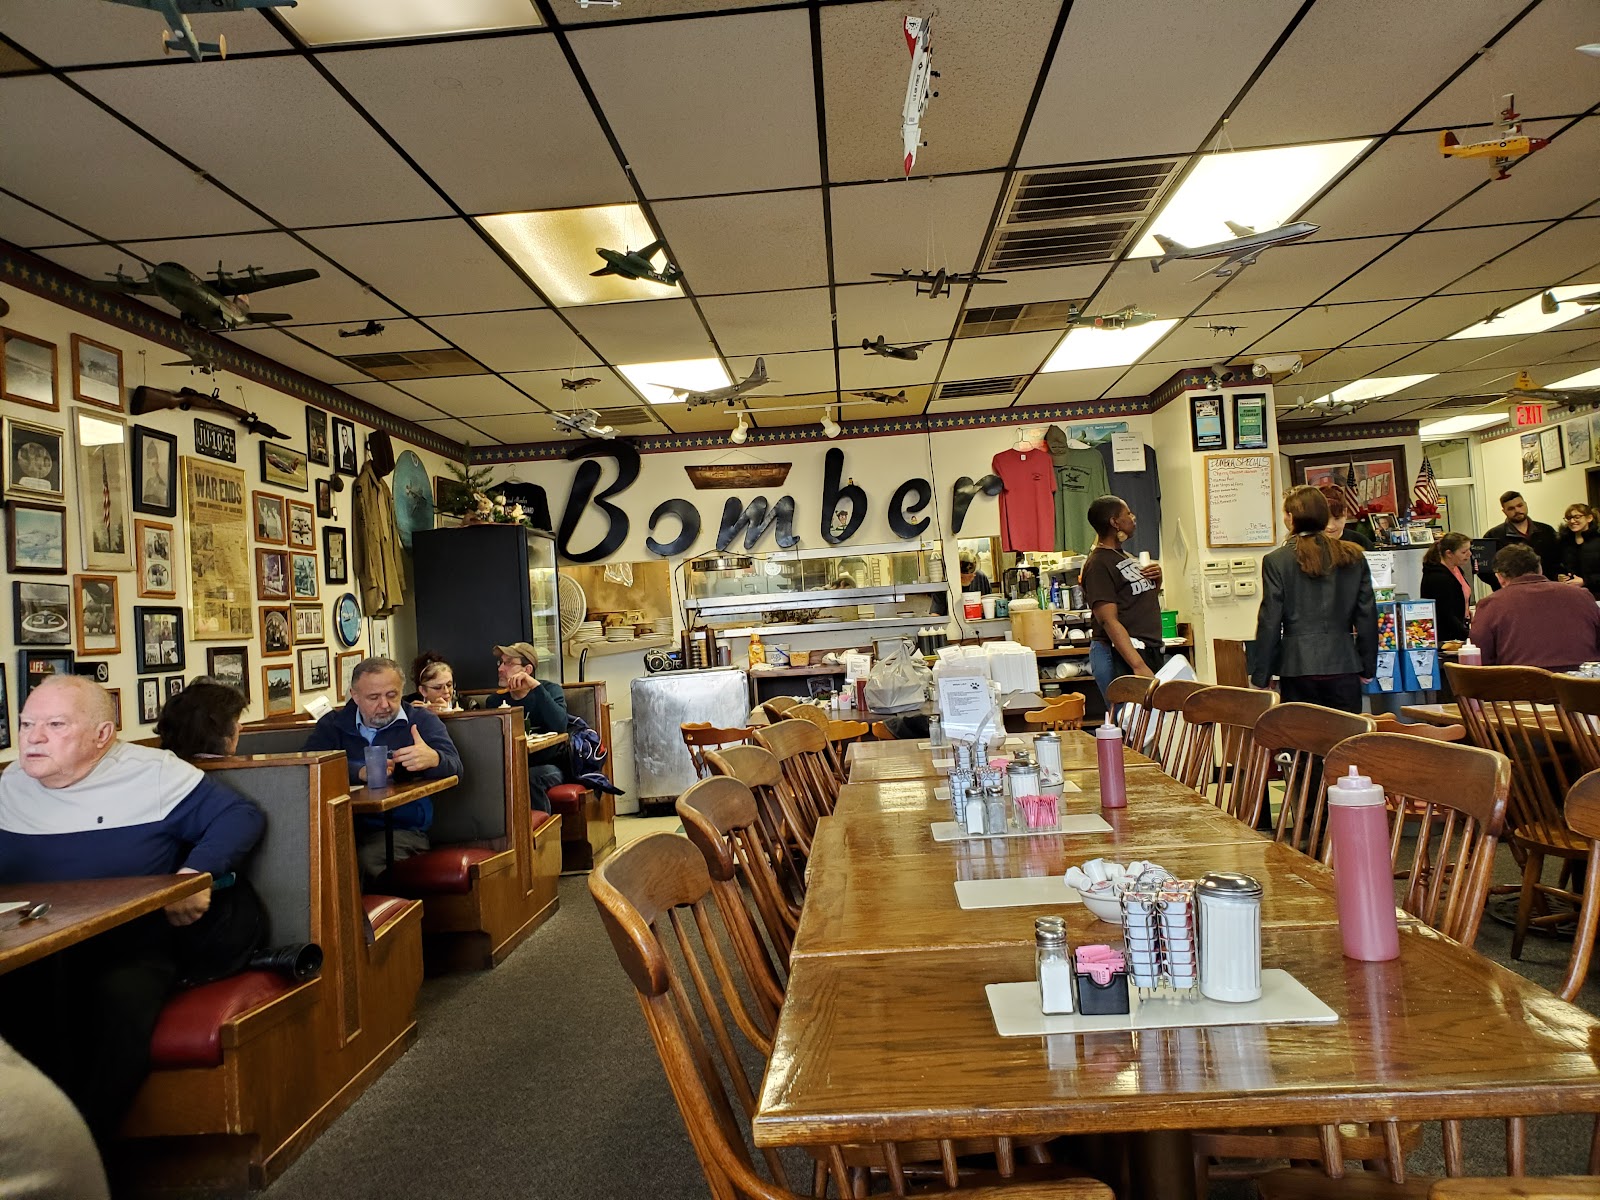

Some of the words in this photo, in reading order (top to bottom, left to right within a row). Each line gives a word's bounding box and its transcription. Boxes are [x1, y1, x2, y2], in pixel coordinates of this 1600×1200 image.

[1516, 404, 1543, 426] EXIT
[194, 472, 219, 502] WAR
[219, 478, 242, 506] ENDS
[557, 438, 1004, 563] Bomber
[32, 614, 60, 625] 32
[29, 660, 44, 673] LIFE
